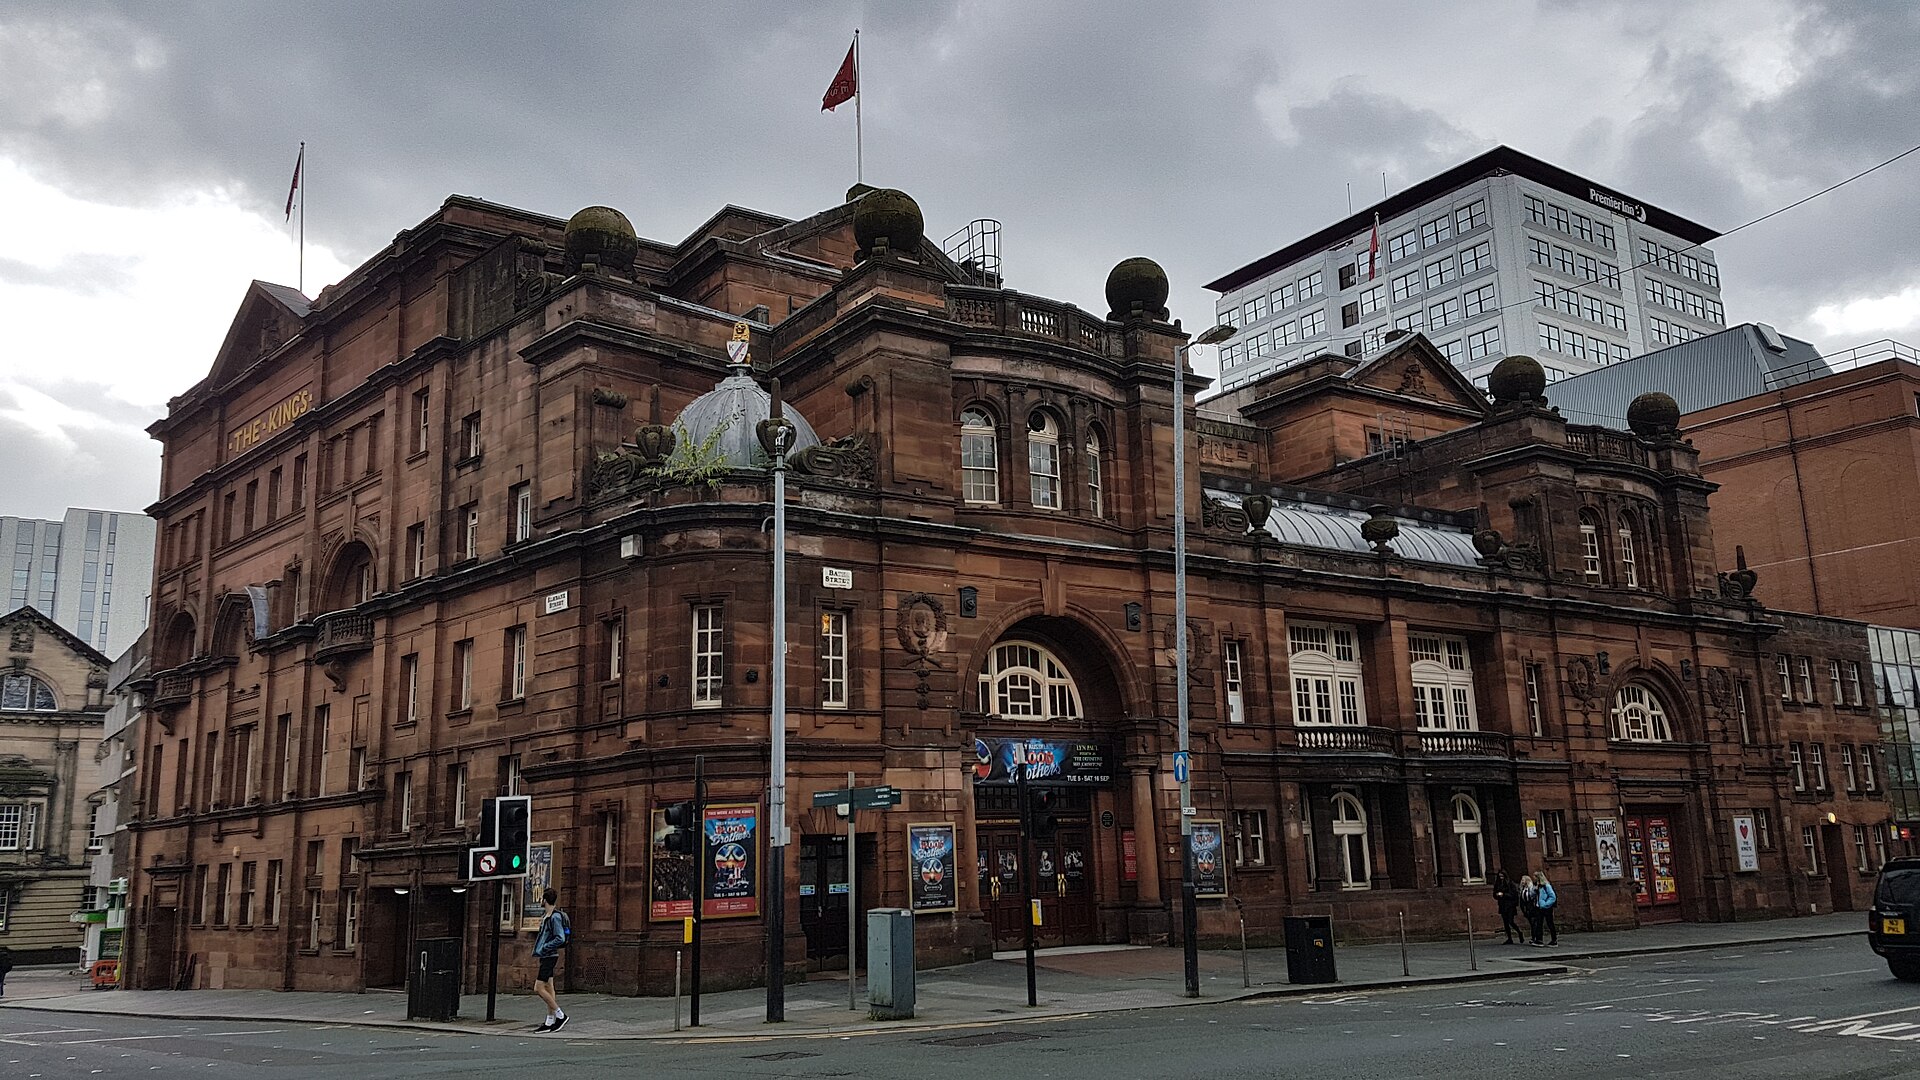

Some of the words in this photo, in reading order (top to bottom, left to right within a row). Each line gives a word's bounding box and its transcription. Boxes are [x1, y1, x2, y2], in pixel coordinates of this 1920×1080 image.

[1589, 188, 1621, 211] Premier
[1622, 201, 1635, 216] Inn
[234, 418, 262, 453] THE
[269, 389, 309, 433] KING'S
[715, 824, 746, 835] BLOOD
